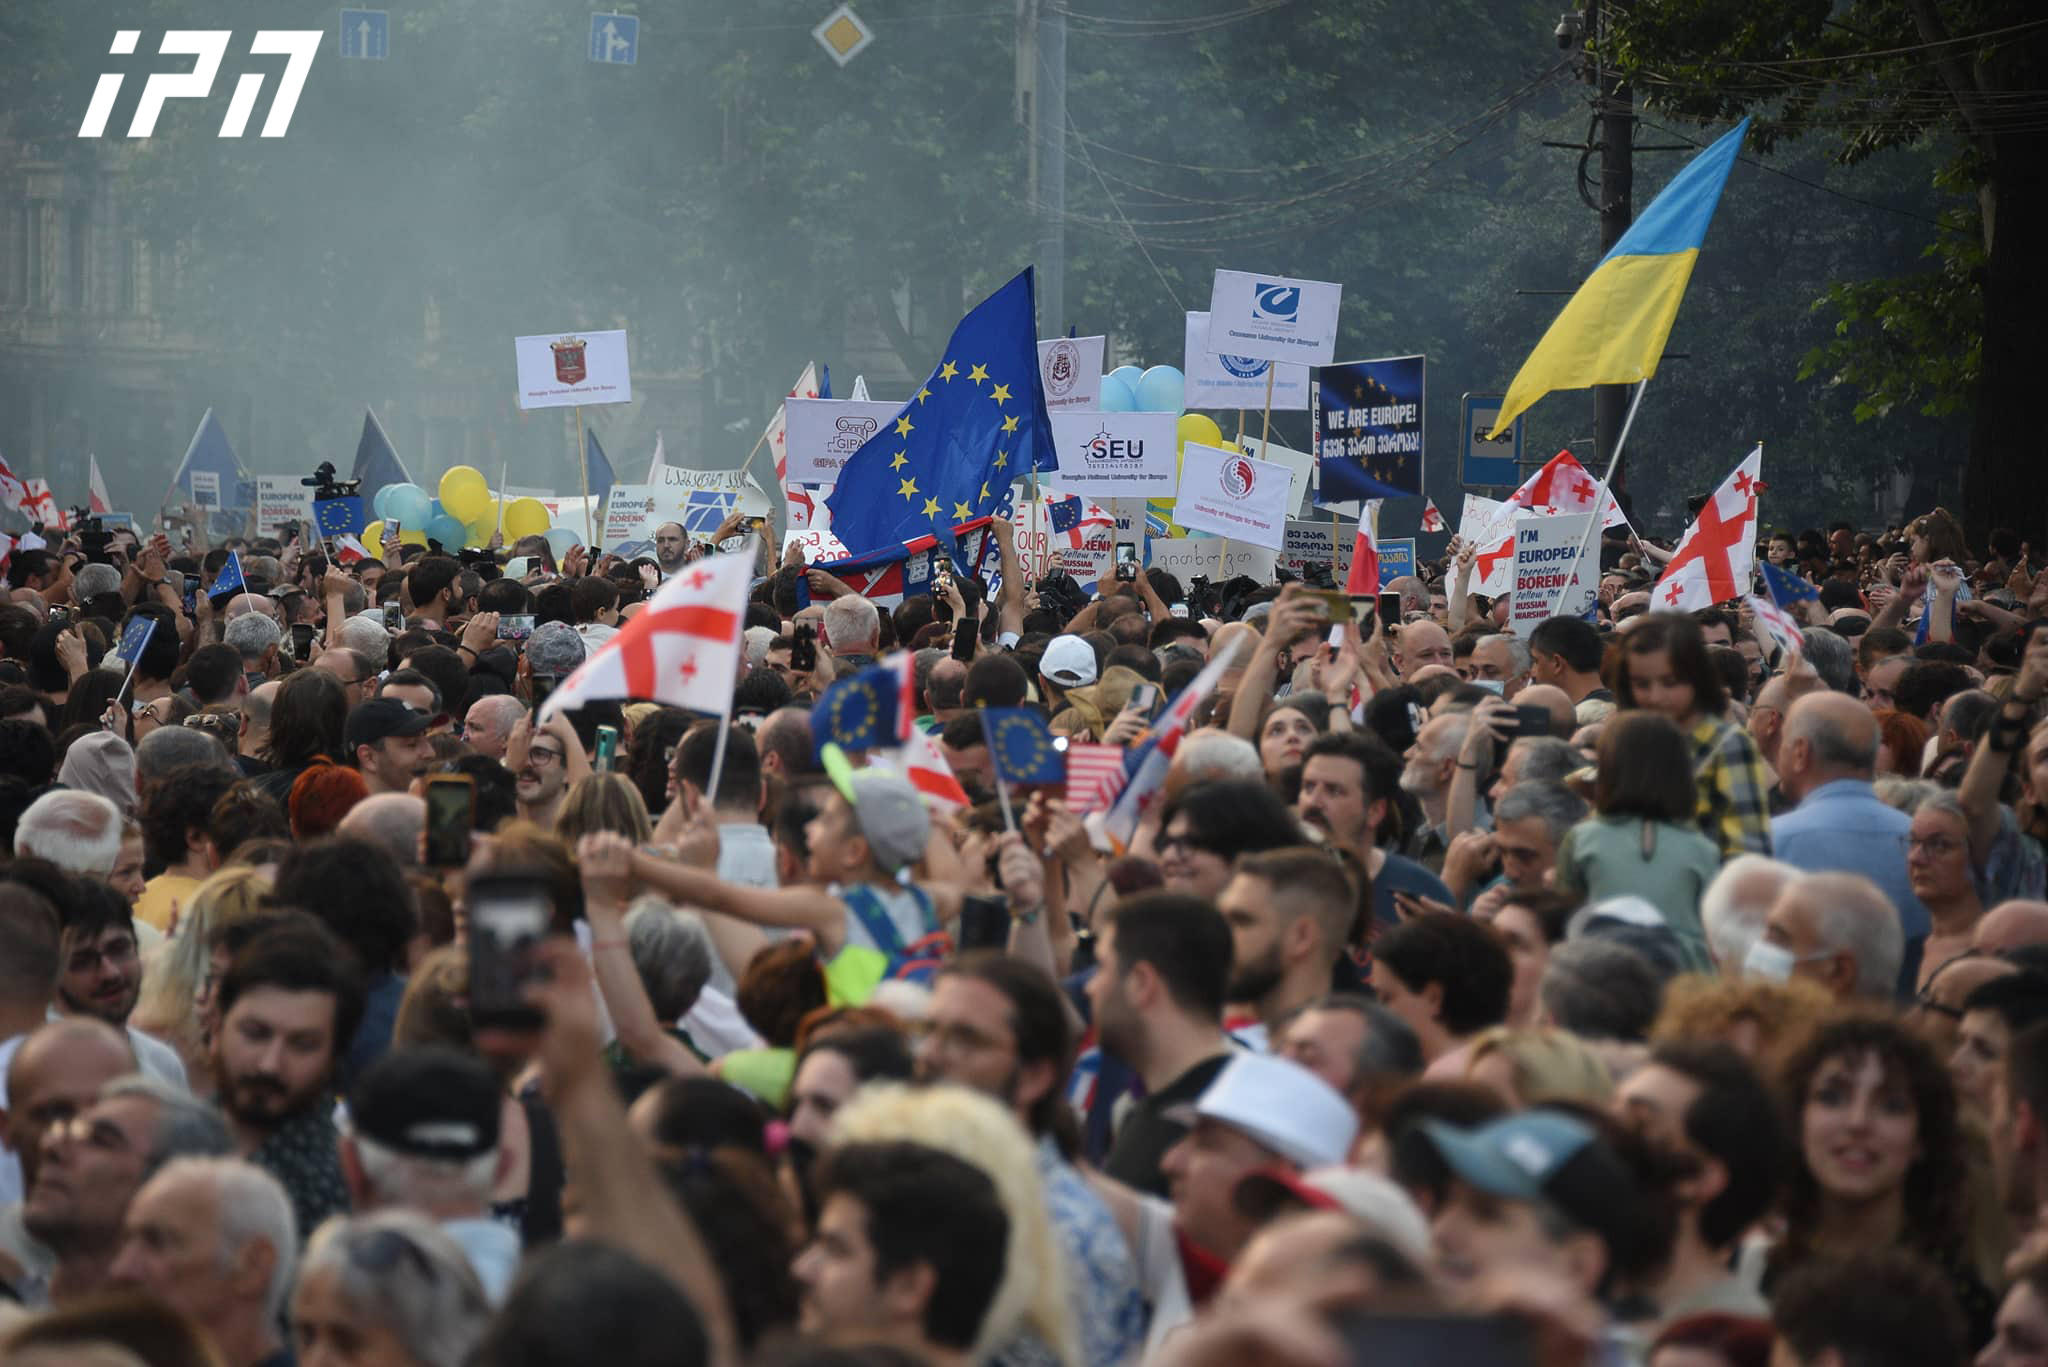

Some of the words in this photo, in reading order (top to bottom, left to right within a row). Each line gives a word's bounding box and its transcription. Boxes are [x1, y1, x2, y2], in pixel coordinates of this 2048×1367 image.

[1328, 410, 1345, 431] WE
[1347, 406, 1369, 429] ARE
[1371, 403, 1417, 426] EUROPE!
[837, 439, 864, 450] GIPA
[1092, 440, 1144, 459] SEU
[1323, 437, 1345, 459] ჩვენ
[1347, 434, 1376, 457] ვართ
[1378, 431, 1420, 454] ევროპა!
[1111, 473, 1138, 481] University
[612, 491, 626, 499] I'M
[608, 515, 646, 523] BORENK
[1287, 529, 1301, 539] მე
[1303, 530, 1326, 541] ვარ
[1520, 530, 1539, 544] I'M
[1093, 550, 1106, 559] the
[1063, 559, 1093, 567] RUSSIAN
[1547, 588, 1561, 597] the
[1516, 600, 1548, 610] RUSSIAN
[1514, 610, 1551, 620] WARSHIP!
